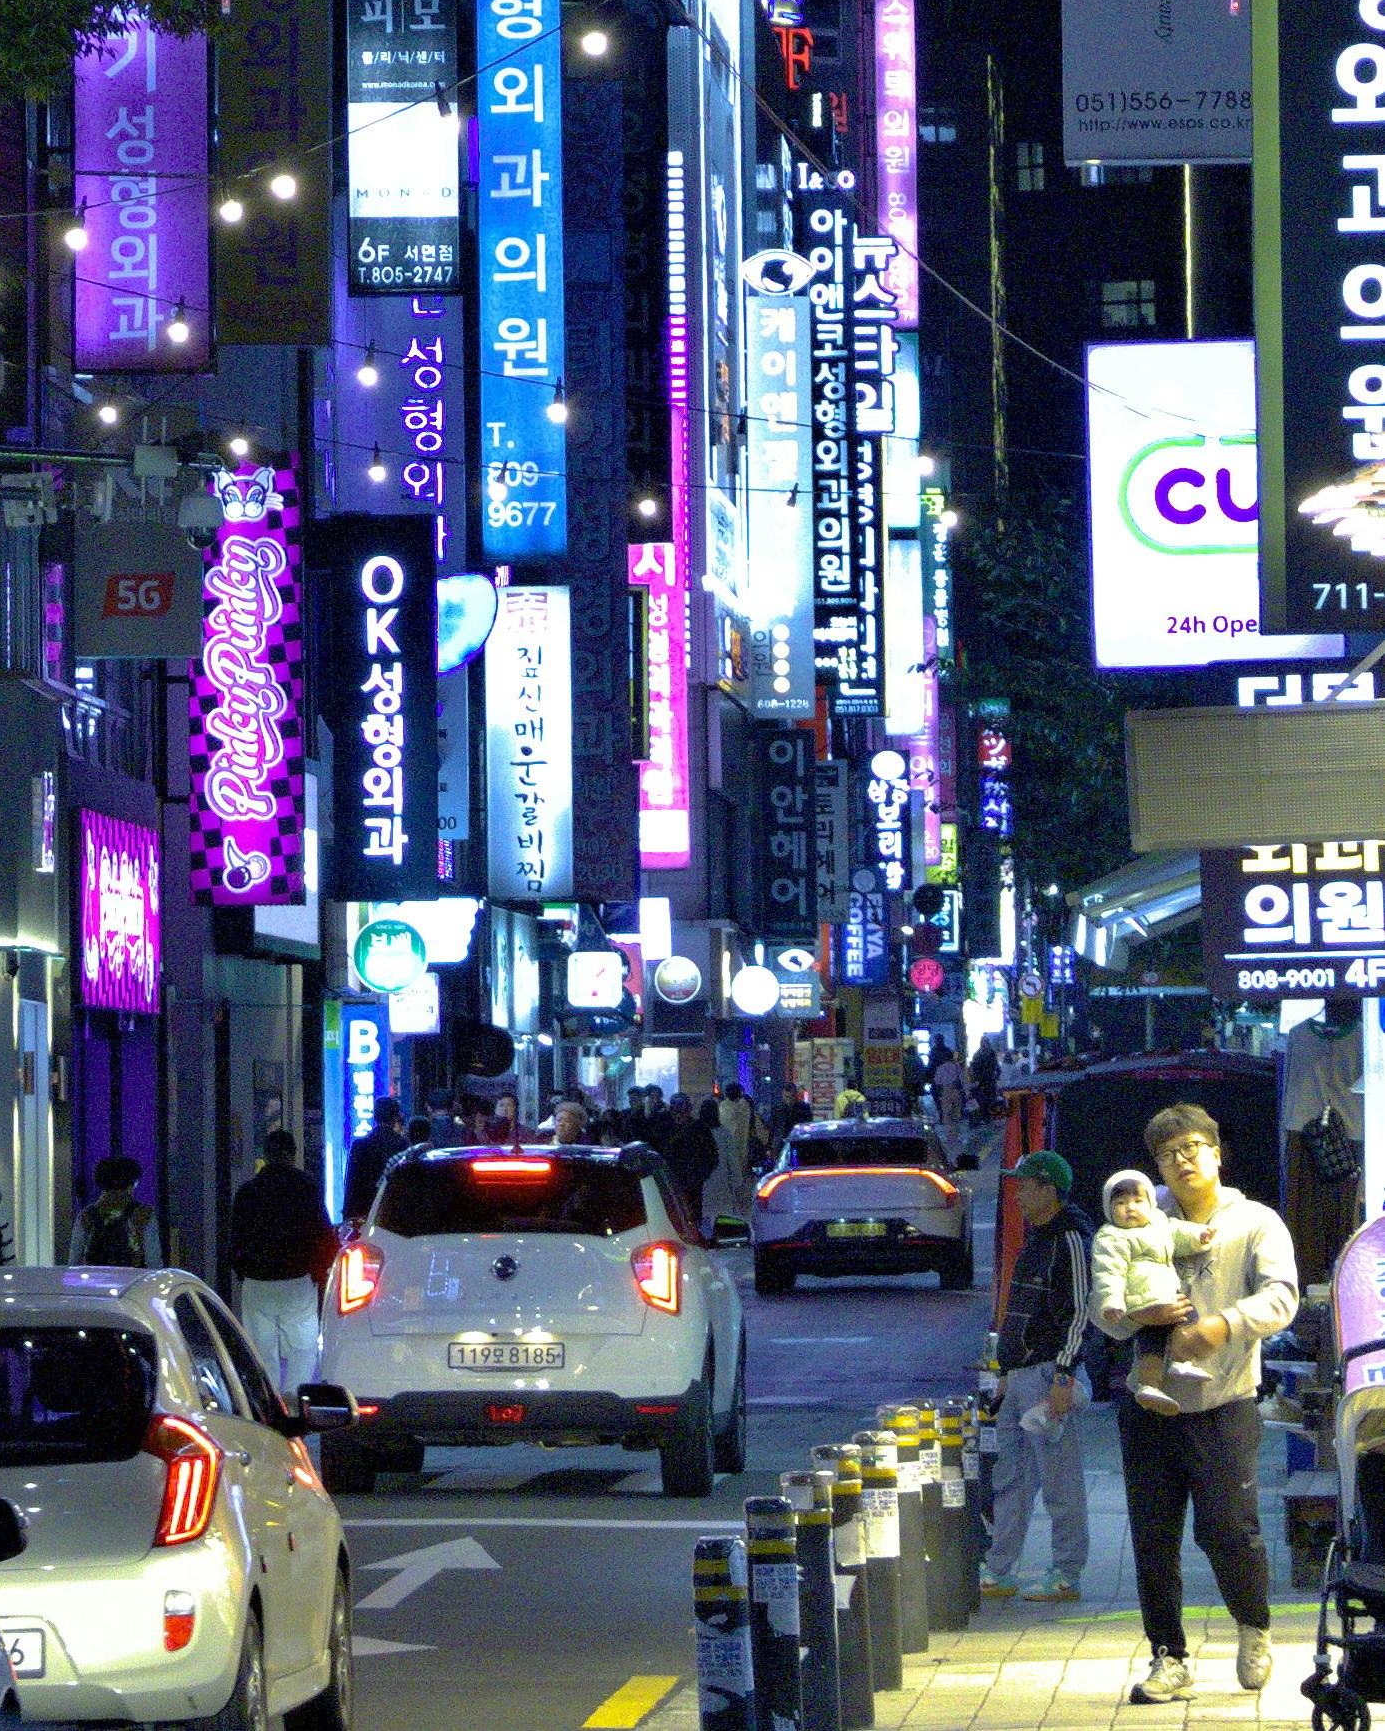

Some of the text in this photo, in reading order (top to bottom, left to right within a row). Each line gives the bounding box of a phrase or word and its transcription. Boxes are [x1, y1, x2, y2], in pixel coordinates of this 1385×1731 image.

[1074, 91, 1253, 114] 051)556-7788
[355, 186, 453, 200] MOND
[105, 104, 164, 351] 성형외과
[358, 237, 390, 263] 6F
[358, 265, 454, 285] T.805-2747
[852, 228, 900, 434] 뉴스타일
[487, 501, 558, 527] 9677
[1154, 467, 1259, 526] CU
[115, 579, 163, 612] 5G
[361, 555, 406, 657] OK
[1166, 614, 1261, 640] 24h Ope
[360, 662, 410, 866] 성형외과
[769, 738, 809, 917] 이안헤어
[1243, 879, 1385, 944] 의원
[848, 893, 867, 978] COFFEE
[1237, 970, 1337, 990] 808-9001
[348, 1020, 381, 1065] B
[455, 1346, 557, 1365] 119모 8185
